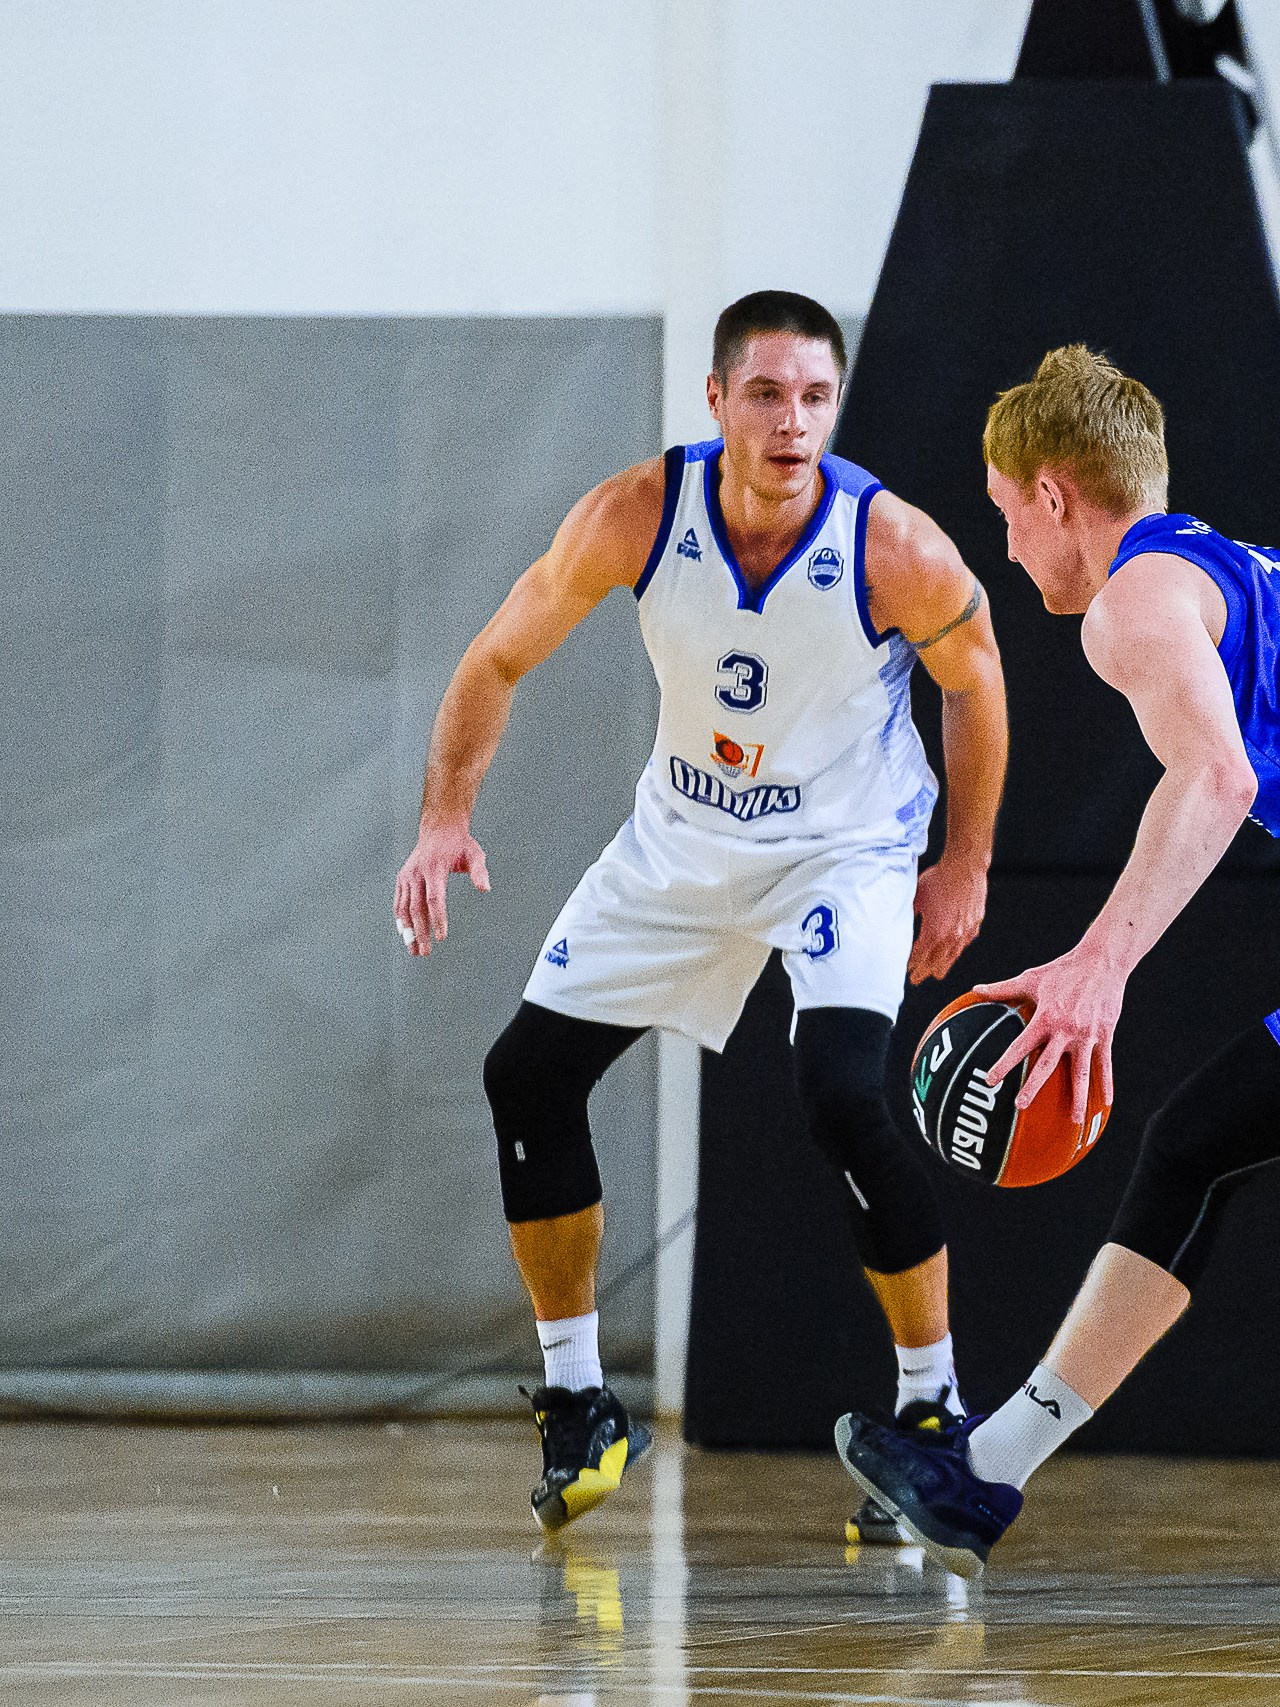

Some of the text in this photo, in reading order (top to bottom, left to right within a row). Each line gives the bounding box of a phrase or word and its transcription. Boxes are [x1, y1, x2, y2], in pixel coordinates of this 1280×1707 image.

[715, 648, 769, 715] 3
[800, 900, 840, 963] 3
[1022, 1381, 1062, 1421] ILA
